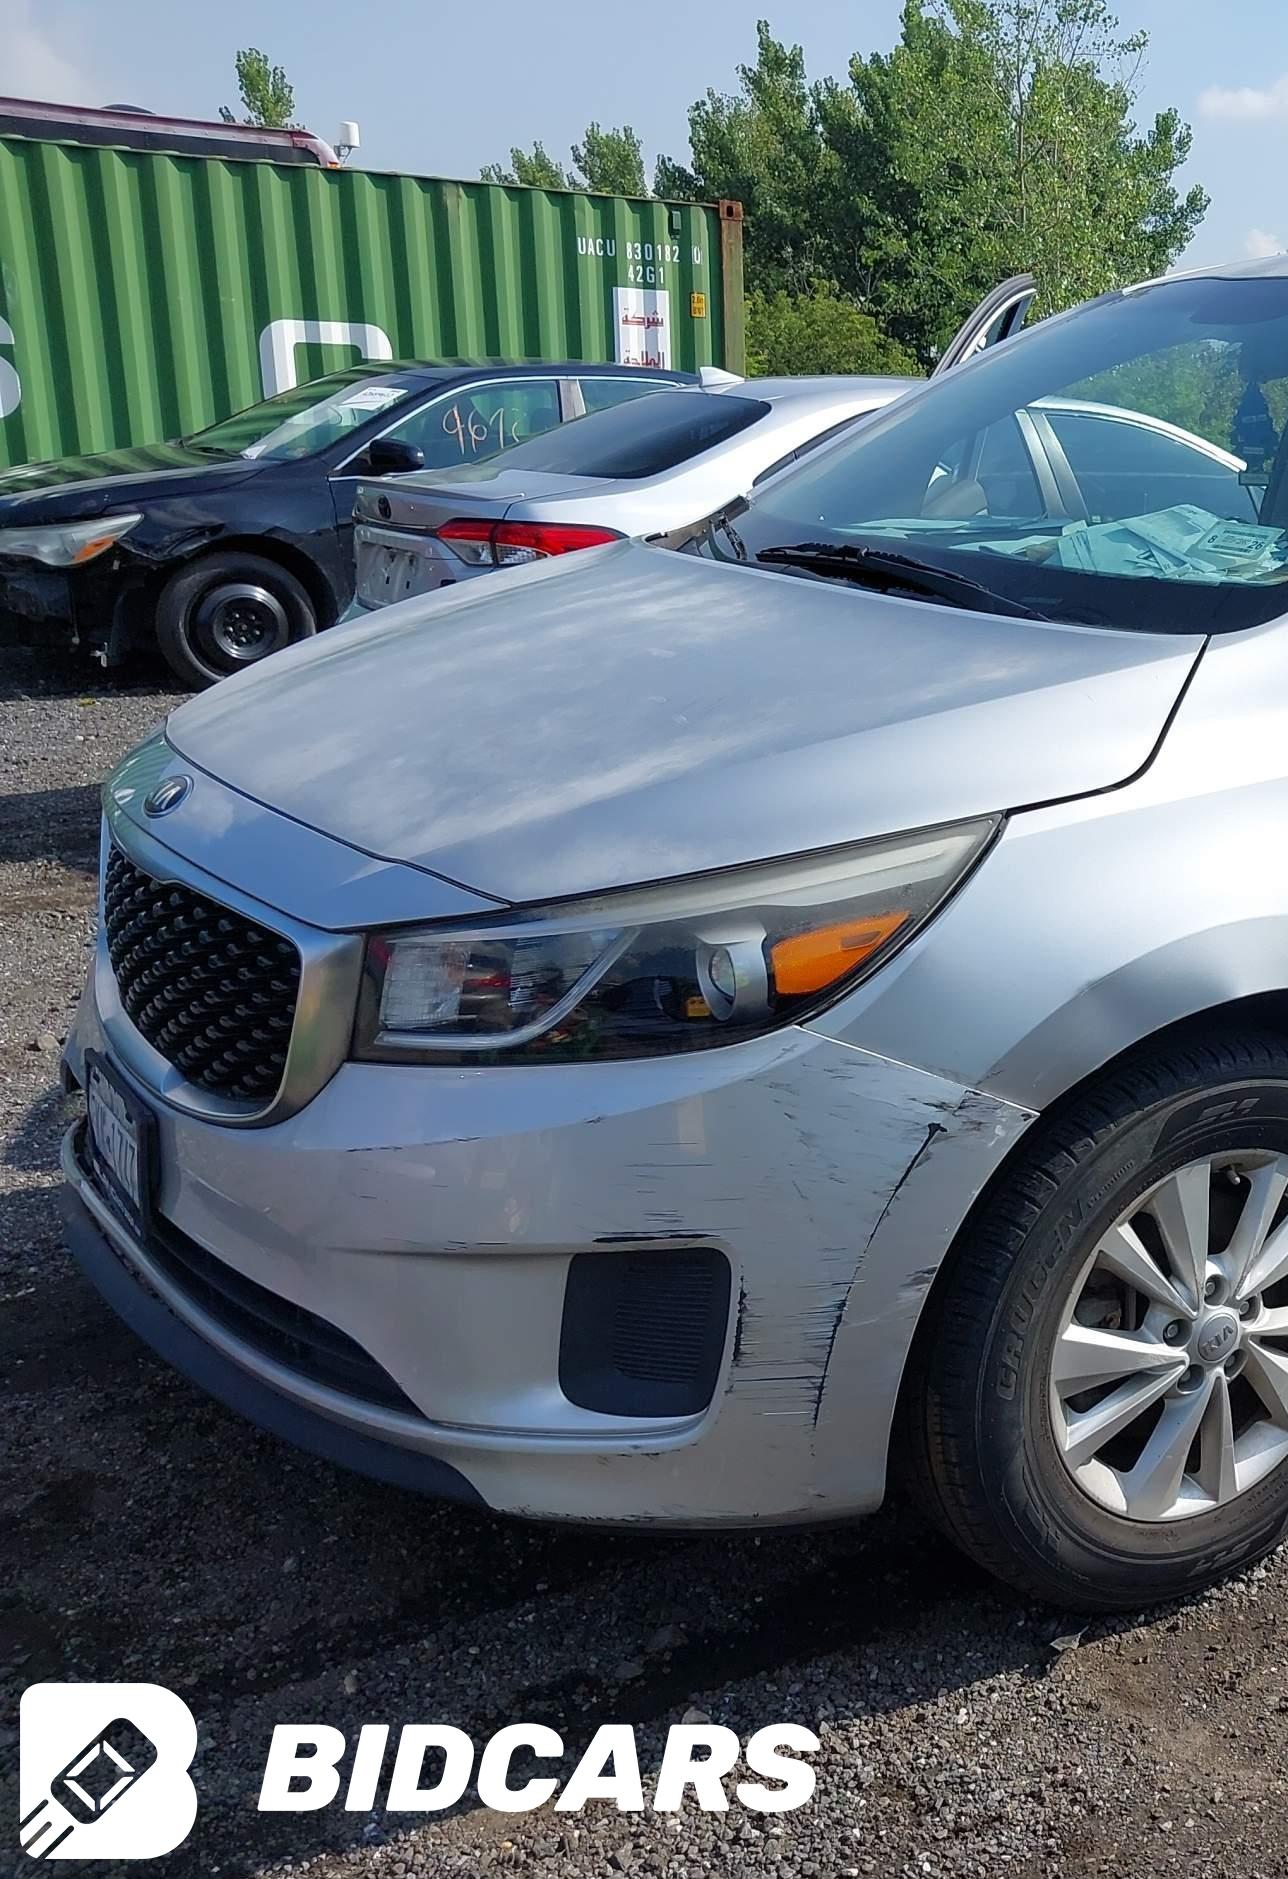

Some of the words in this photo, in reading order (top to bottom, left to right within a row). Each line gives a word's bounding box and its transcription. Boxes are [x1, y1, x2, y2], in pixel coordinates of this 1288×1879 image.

[577, 237, 616, 257] UACU
[626, 242, 680, 263] 830182
[627, 266, 665, 283] 42G1
